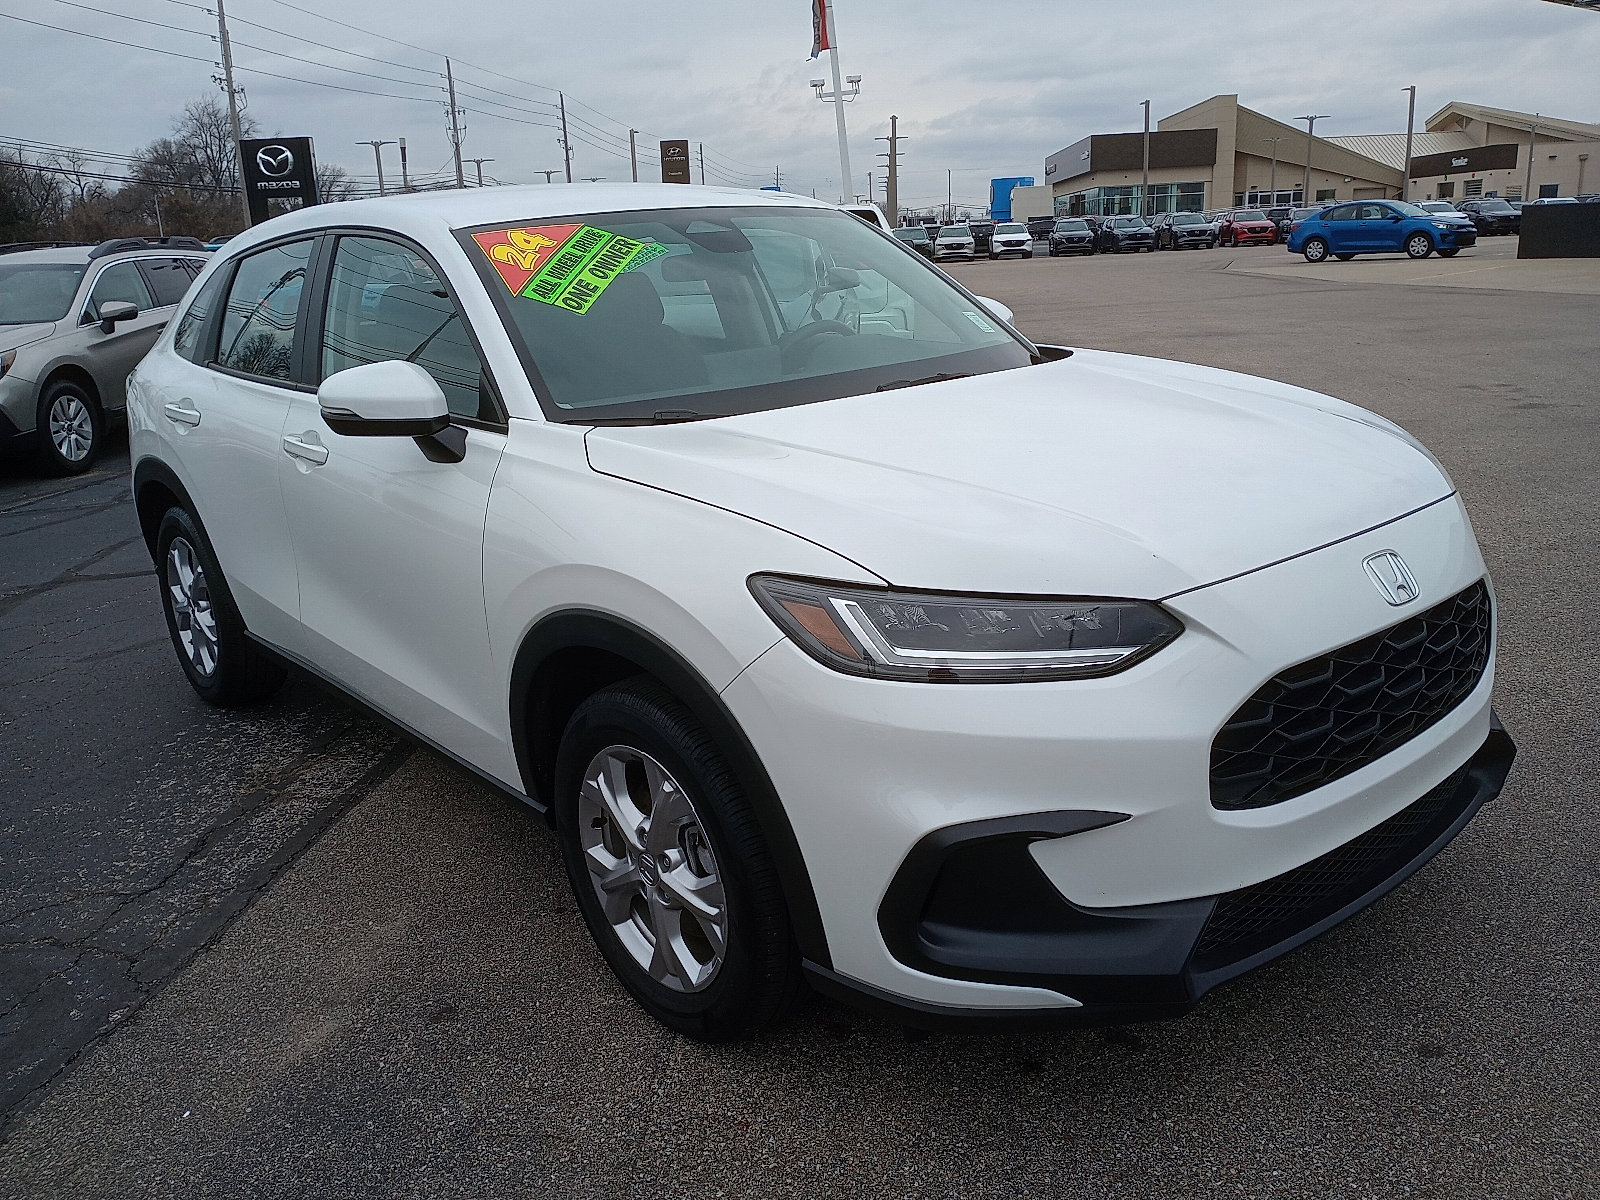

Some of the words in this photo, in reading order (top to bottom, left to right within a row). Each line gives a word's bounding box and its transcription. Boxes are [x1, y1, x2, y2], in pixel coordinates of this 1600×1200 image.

[489, 229, 558, 271] 24
[570, 229, 607, 257] DRIVE
[545, 252, 584, 281] WHEEL
[561, 278, 600, 311] ONE
[588, 238, 641, 280] OWNER
[530, 278, 562, 300] ALL
